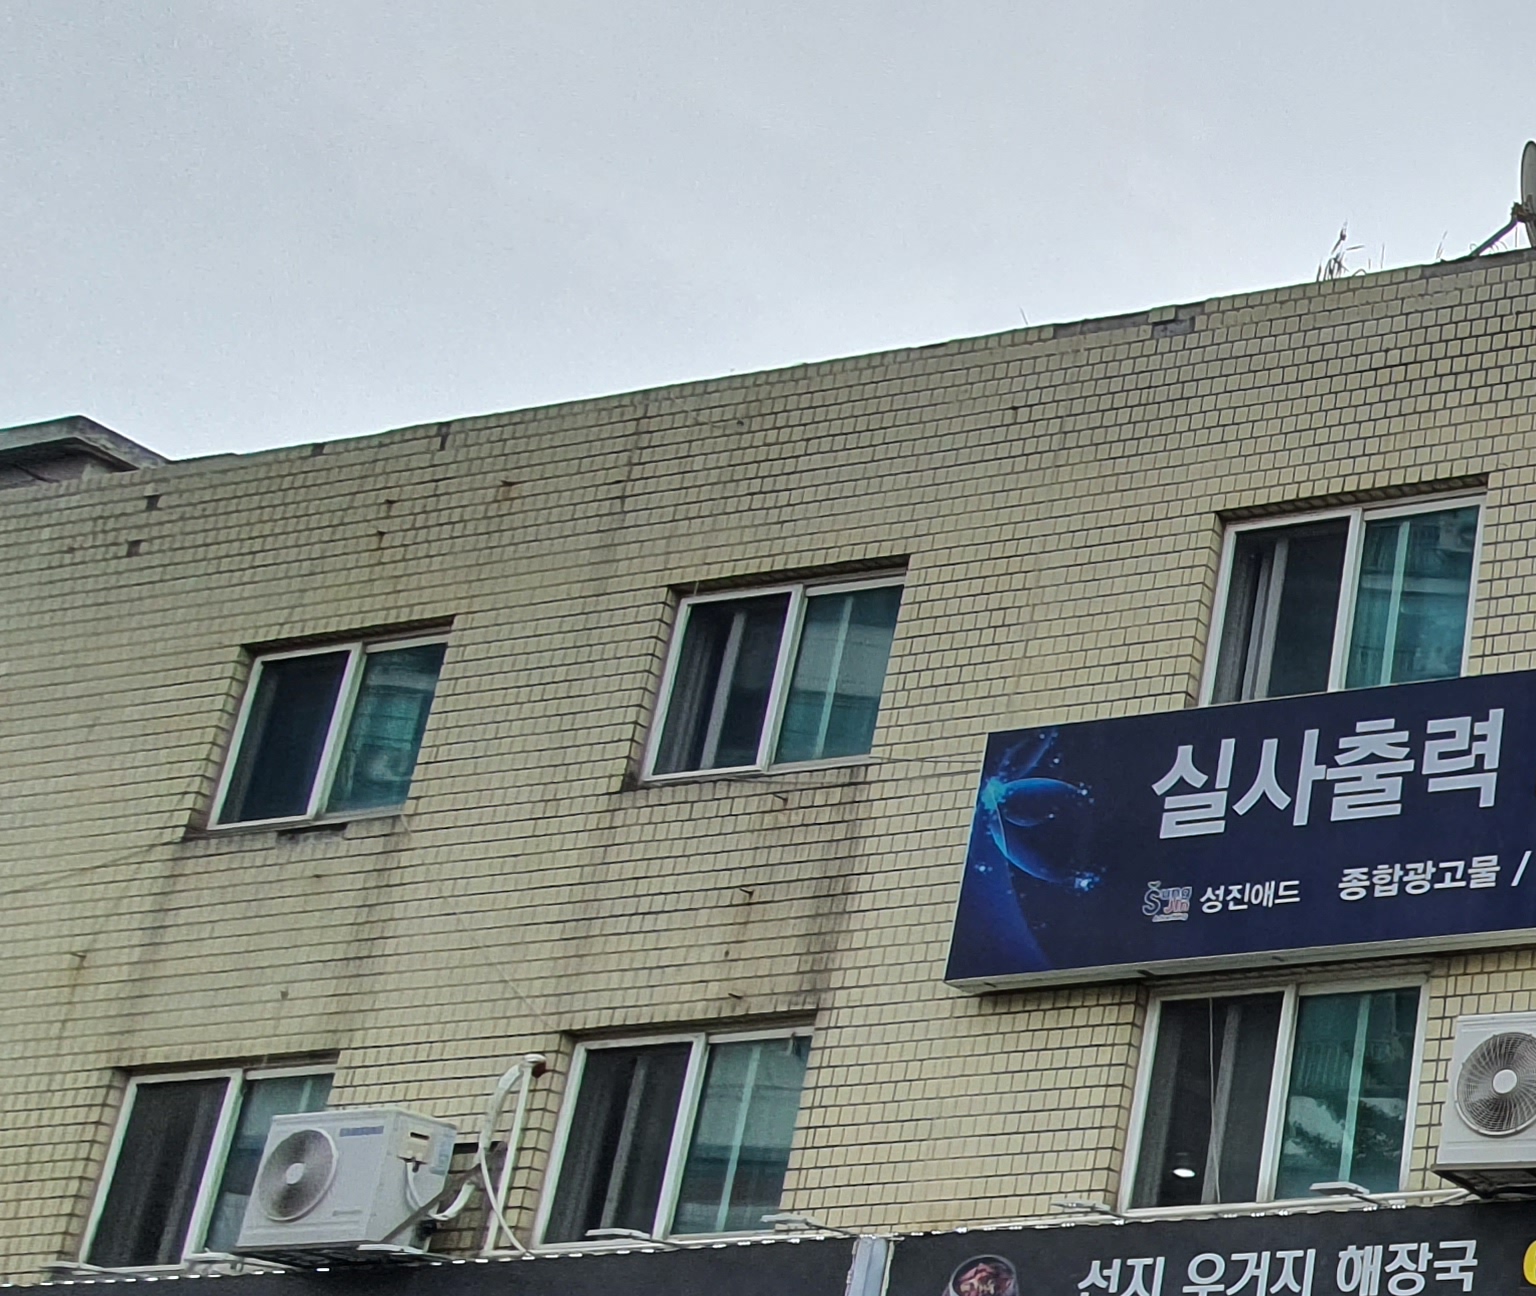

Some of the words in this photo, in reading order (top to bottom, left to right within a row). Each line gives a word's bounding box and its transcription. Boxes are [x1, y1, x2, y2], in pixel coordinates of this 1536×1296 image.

[1151, 708, 1505, 840] 실사출력
[1200, 879, 1300, 914] 성진애드
[1338, 854, 1500, 900] 종합광고물
[1336, 1240, 1478, 1295] 해장국
